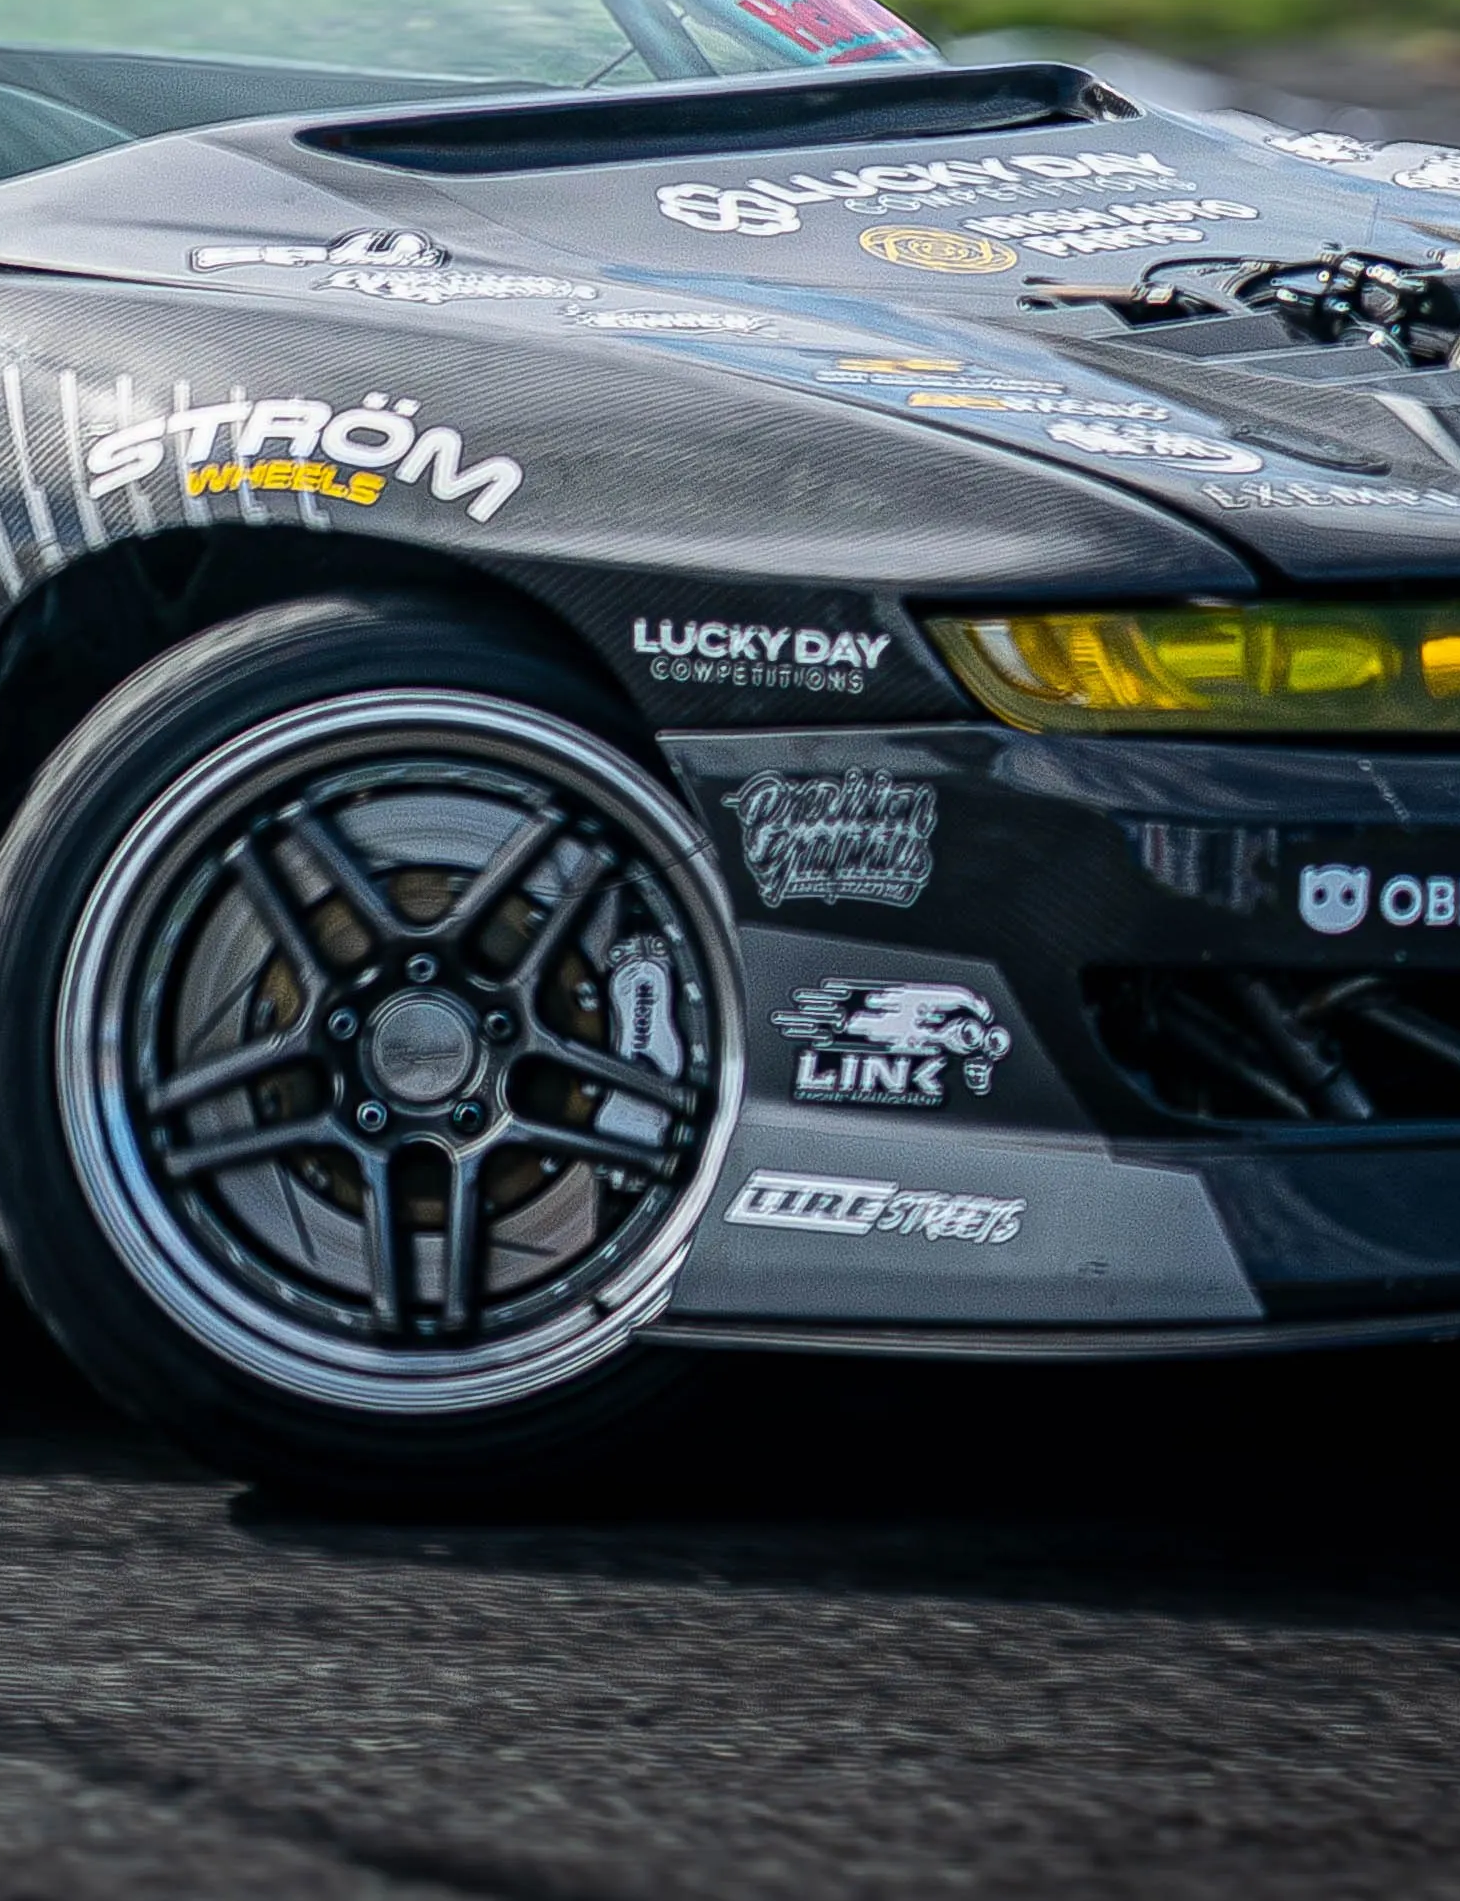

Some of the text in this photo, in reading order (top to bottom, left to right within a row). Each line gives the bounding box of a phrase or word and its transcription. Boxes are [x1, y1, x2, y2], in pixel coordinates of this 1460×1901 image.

[779, 156, 1022, 205] LUCKY
[86, 391, 524, 523] STRÖM
[187, 459, 387, 505] WHEELS
[634, 617, 891, 669] LUCKY DAY
[650, 655, 864, 694] COMPETITIONS
[796, 1050, 946, 1096] LINK
